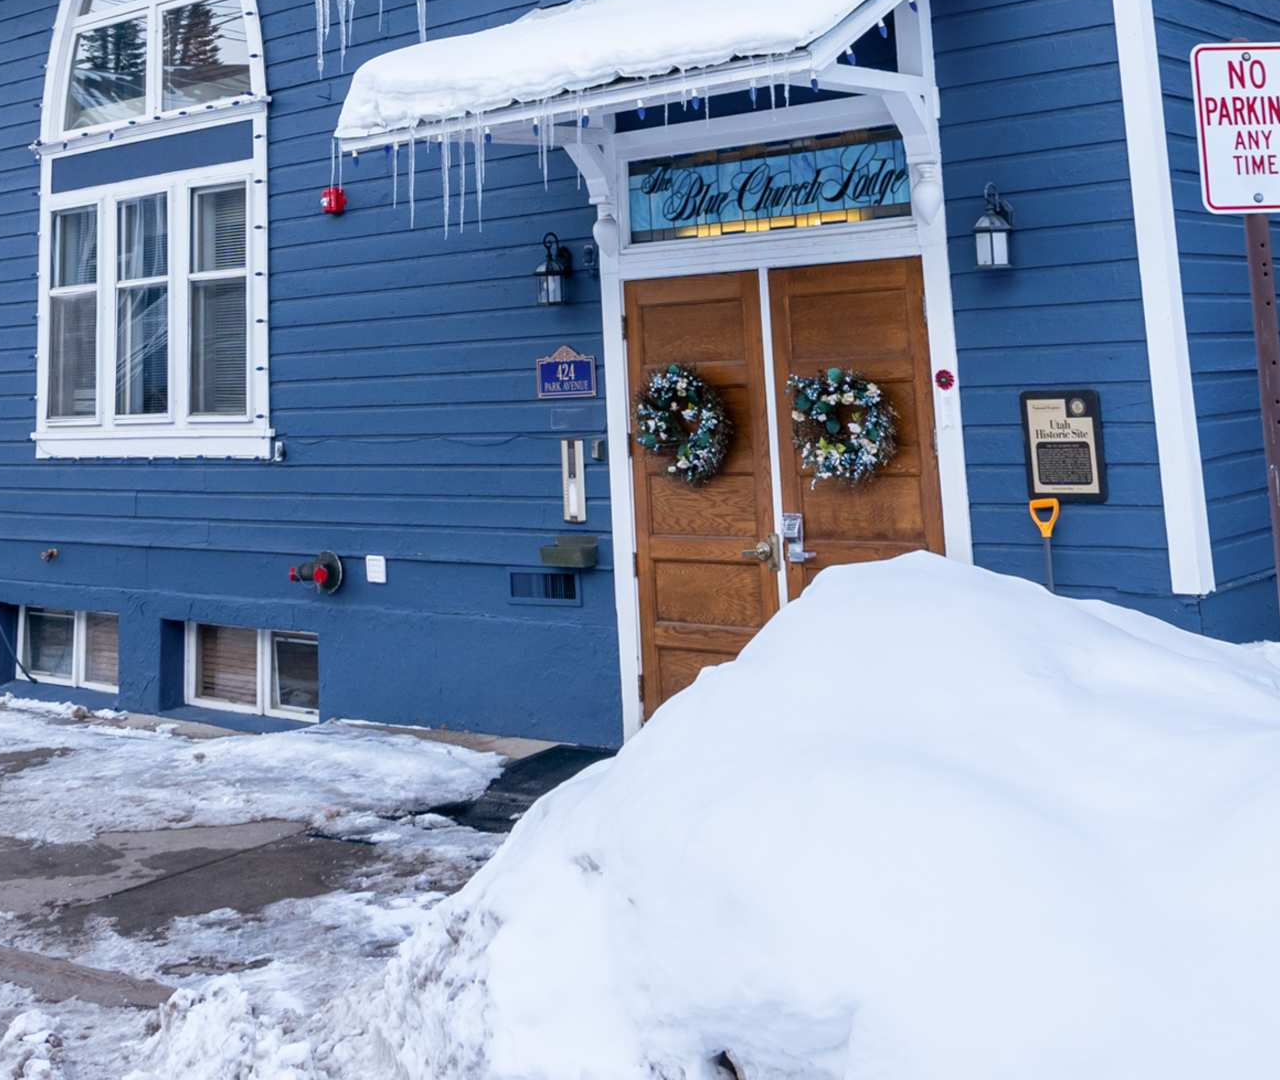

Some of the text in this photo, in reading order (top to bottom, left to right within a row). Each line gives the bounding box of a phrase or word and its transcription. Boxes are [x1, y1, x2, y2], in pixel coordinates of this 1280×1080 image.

[1227, 59, 1266, 89] NO
[1235, 130, 1272, 150] ANY
[1233, 155, 1279, 175] TIME
[641, 142, 908, 221] The Blue Church Lodge
[556, 363, 575, 380] 424
[544, 380, 589, 392] PARK AVENUE
[1049, 419, 1071, 429] Utah
[1035, 428, 1088, 439] Historic Site
